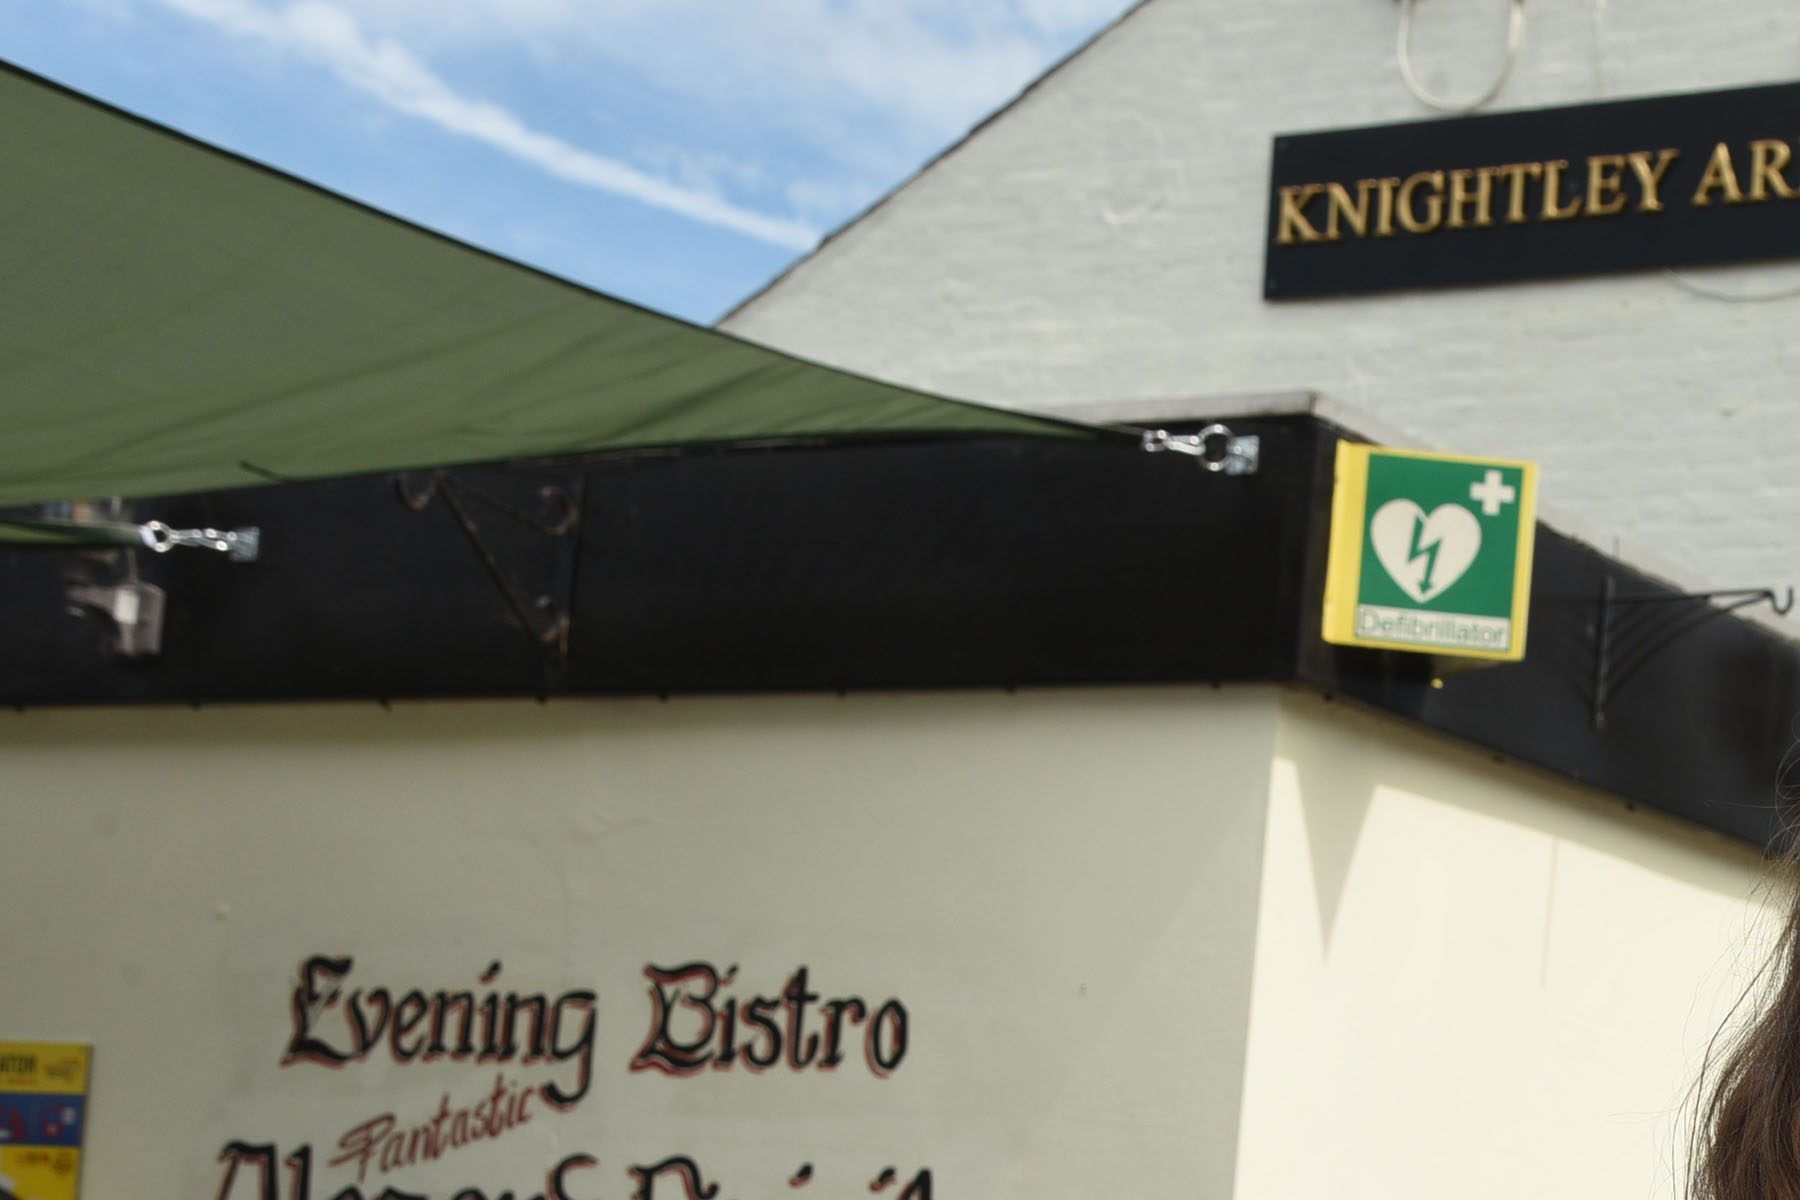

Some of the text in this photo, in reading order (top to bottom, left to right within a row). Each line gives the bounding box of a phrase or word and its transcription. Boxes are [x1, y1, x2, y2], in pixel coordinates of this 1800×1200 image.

[1276, 149, 1678, 244] KNIGHTLEY
[1361, 611, 1504, 643] Defibrillator
[281, 955, 910, 1108] Evening Bistro
[328, 1073, 536, 1182] Fantastic
